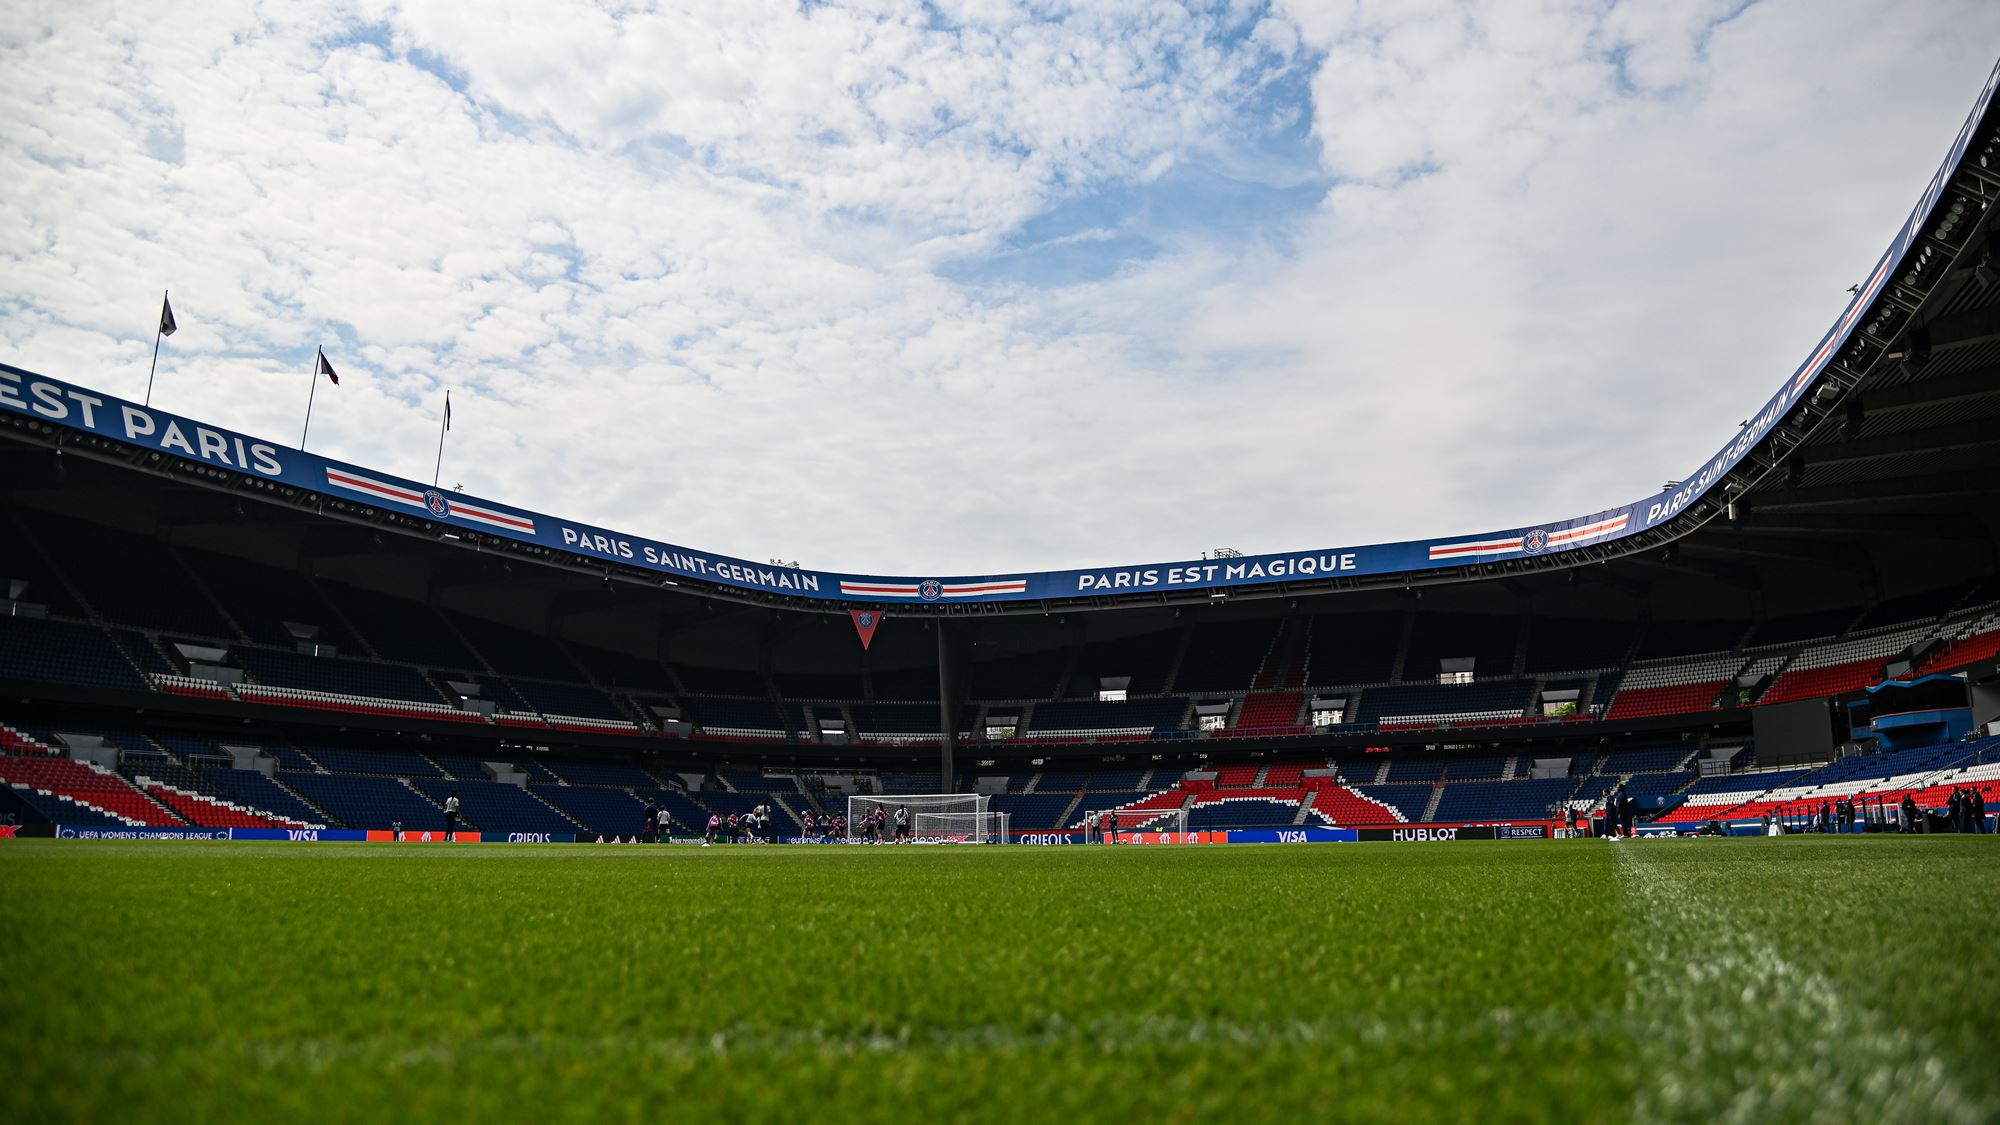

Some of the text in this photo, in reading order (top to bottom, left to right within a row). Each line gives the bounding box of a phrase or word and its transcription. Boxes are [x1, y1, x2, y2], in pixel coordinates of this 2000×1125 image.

[121, 405, 282, 476] PARIS
[1646, 384, 1792, 525] PARIS SAINT-GERMAIN
[562, 527, 819, 591] PARIS SAINT-GERMAIN
[1077, 553, 1356, 590] PARIS EST MAGIQUE
[79, 831, 212, 840] UEFA WOMEN'S CHAMPIONS LEAGUE
[287, 830, 318, 841] VISA
[508, 832, 551, 843] GRIFOLS
[1276, 831, 1307, 842] VISA
[1393, 828, 1458, 841] HUBLOT
[1511, 828, 1543, 836] RESPECT
[1020, 833, 1071, 844] GRIFOLS
